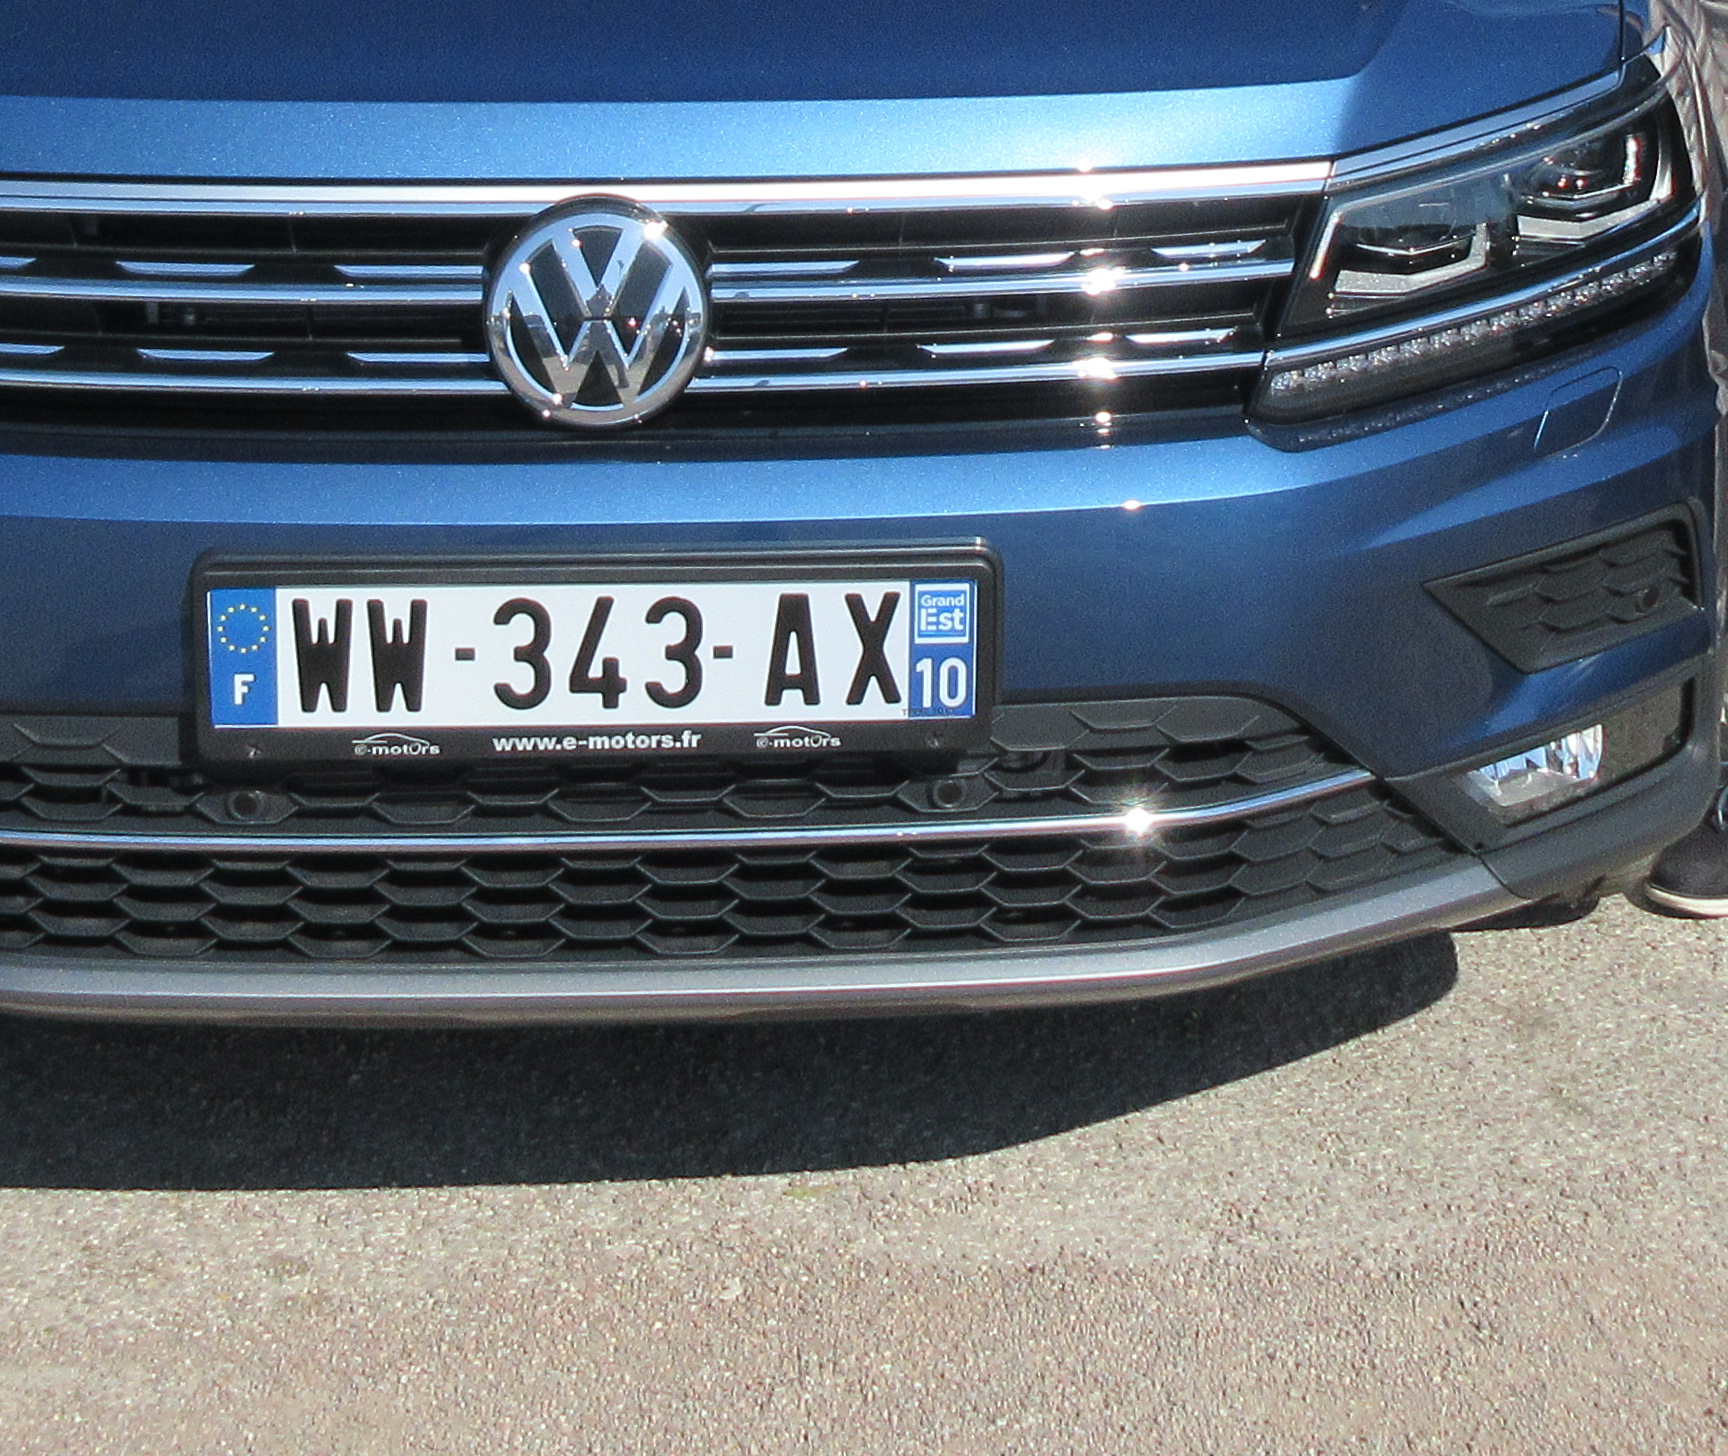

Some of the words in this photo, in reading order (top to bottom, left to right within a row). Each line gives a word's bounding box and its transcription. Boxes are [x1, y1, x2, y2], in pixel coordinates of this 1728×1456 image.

[921, 594, 964, 607] Grand
[920, 608, 964, 631] Est
[233, 674, 255, 705] F
[915, 657, 967, 708] 10
[492, 731, 702, 751] www.e-motors.fr
